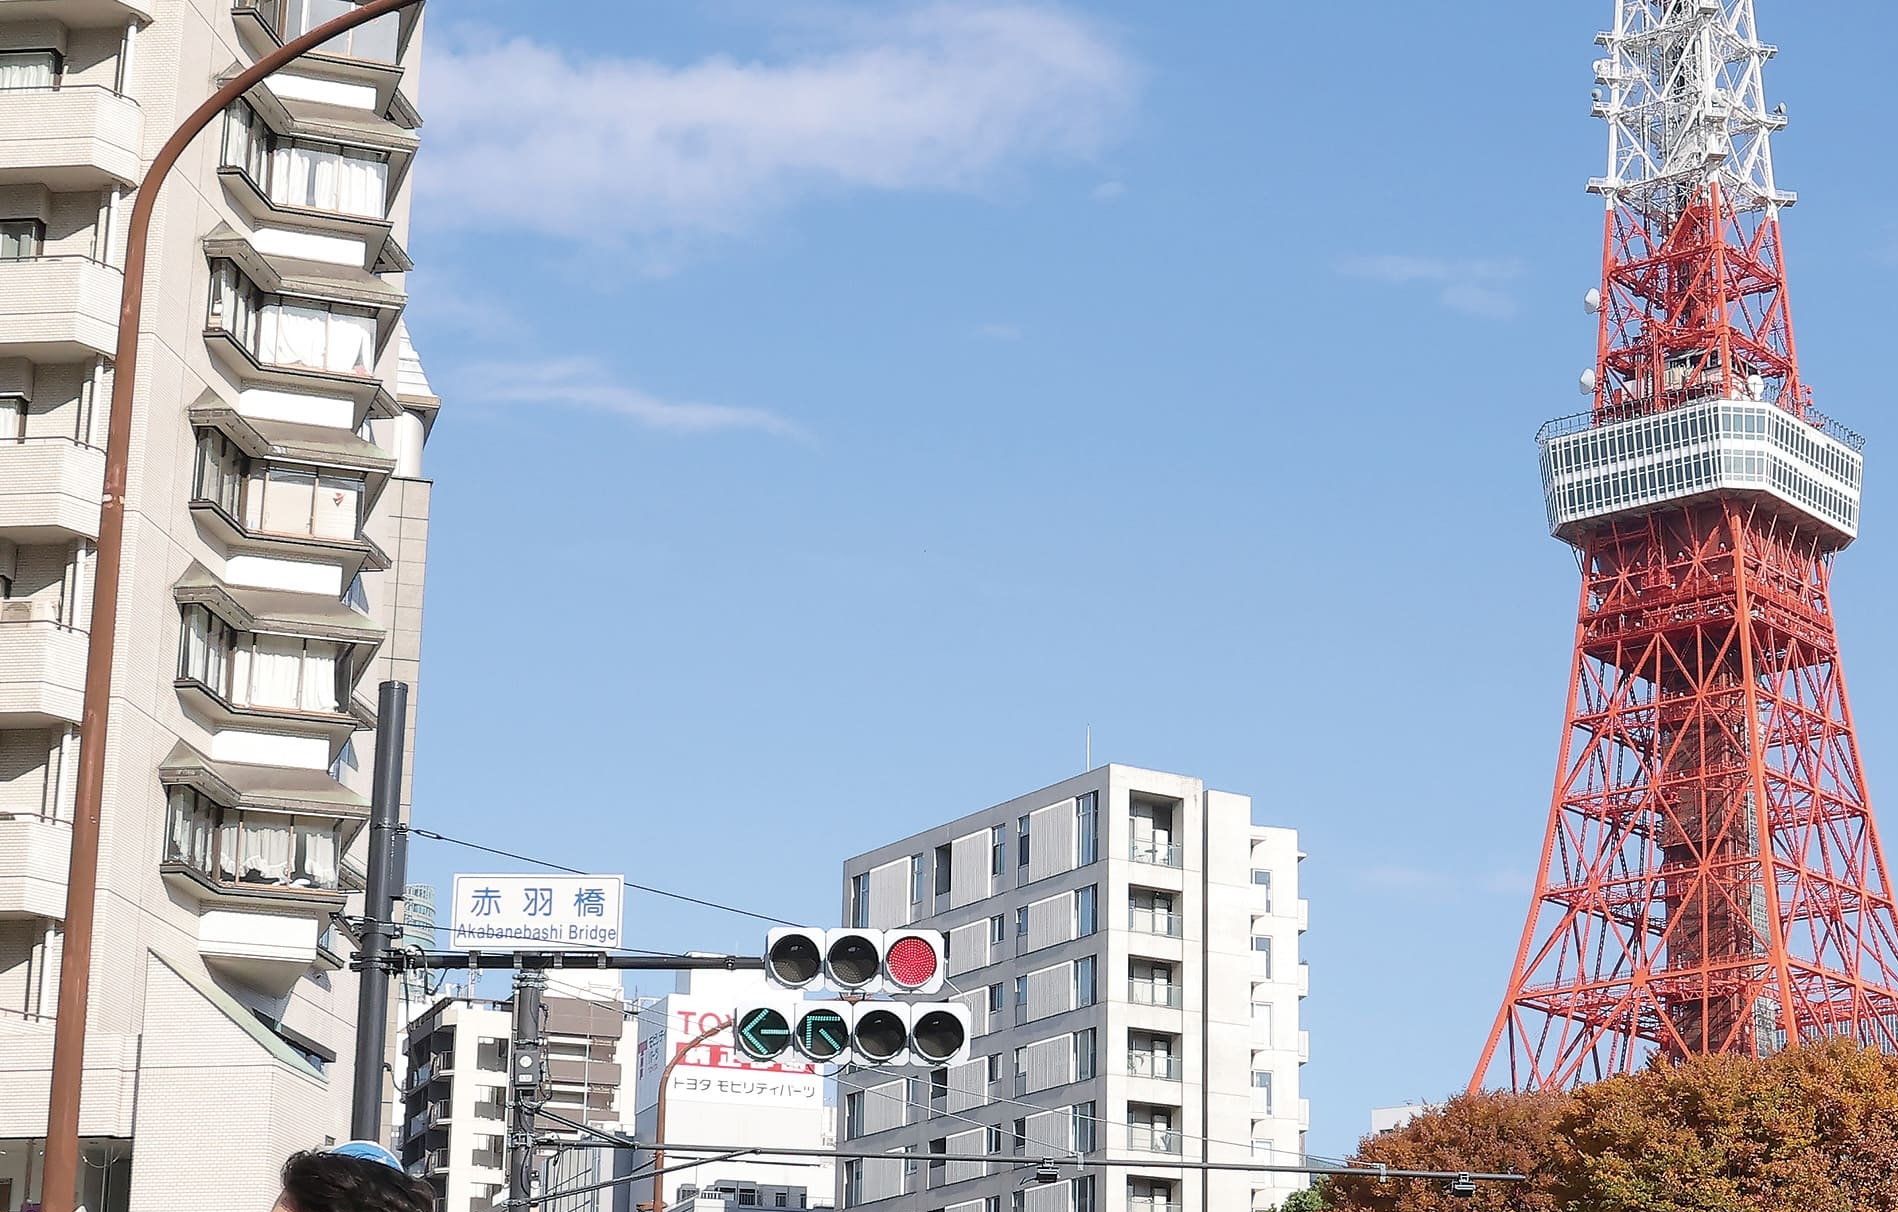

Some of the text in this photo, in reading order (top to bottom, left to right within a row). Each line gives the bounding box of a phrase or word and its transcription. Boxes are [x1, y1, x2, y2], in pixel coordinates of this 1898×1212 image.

[470, 886, 606, 917] 赤羽橋
[456, 923, 617, 943] Akabanebashi Bridge
[677, 1010, 733, 1036] TO
[674, 1077, 711, 1091] トヨタ
